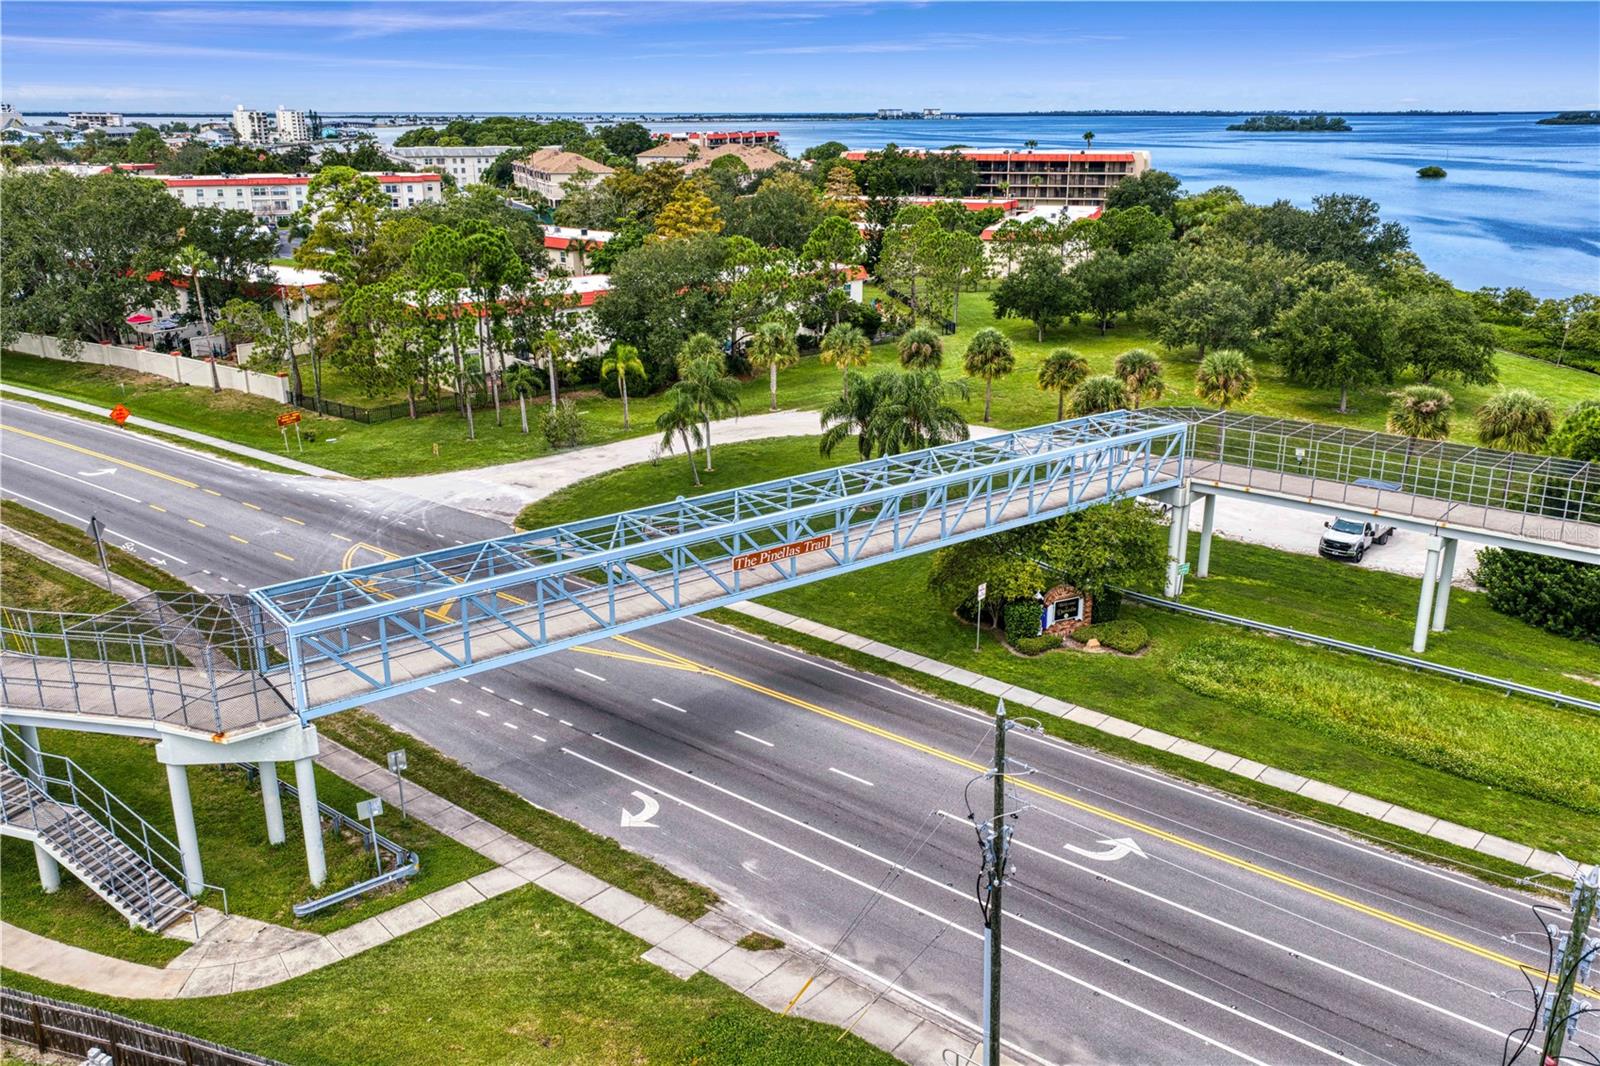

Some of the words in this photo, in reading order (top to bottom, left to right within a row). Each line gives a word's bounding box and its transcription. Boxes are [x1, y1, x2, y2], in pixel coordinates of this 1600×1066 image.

[735, 555, 757, 569] The
[760, 545, 800, 563] Pinellas
[804, 538, 828, 552] Trail
